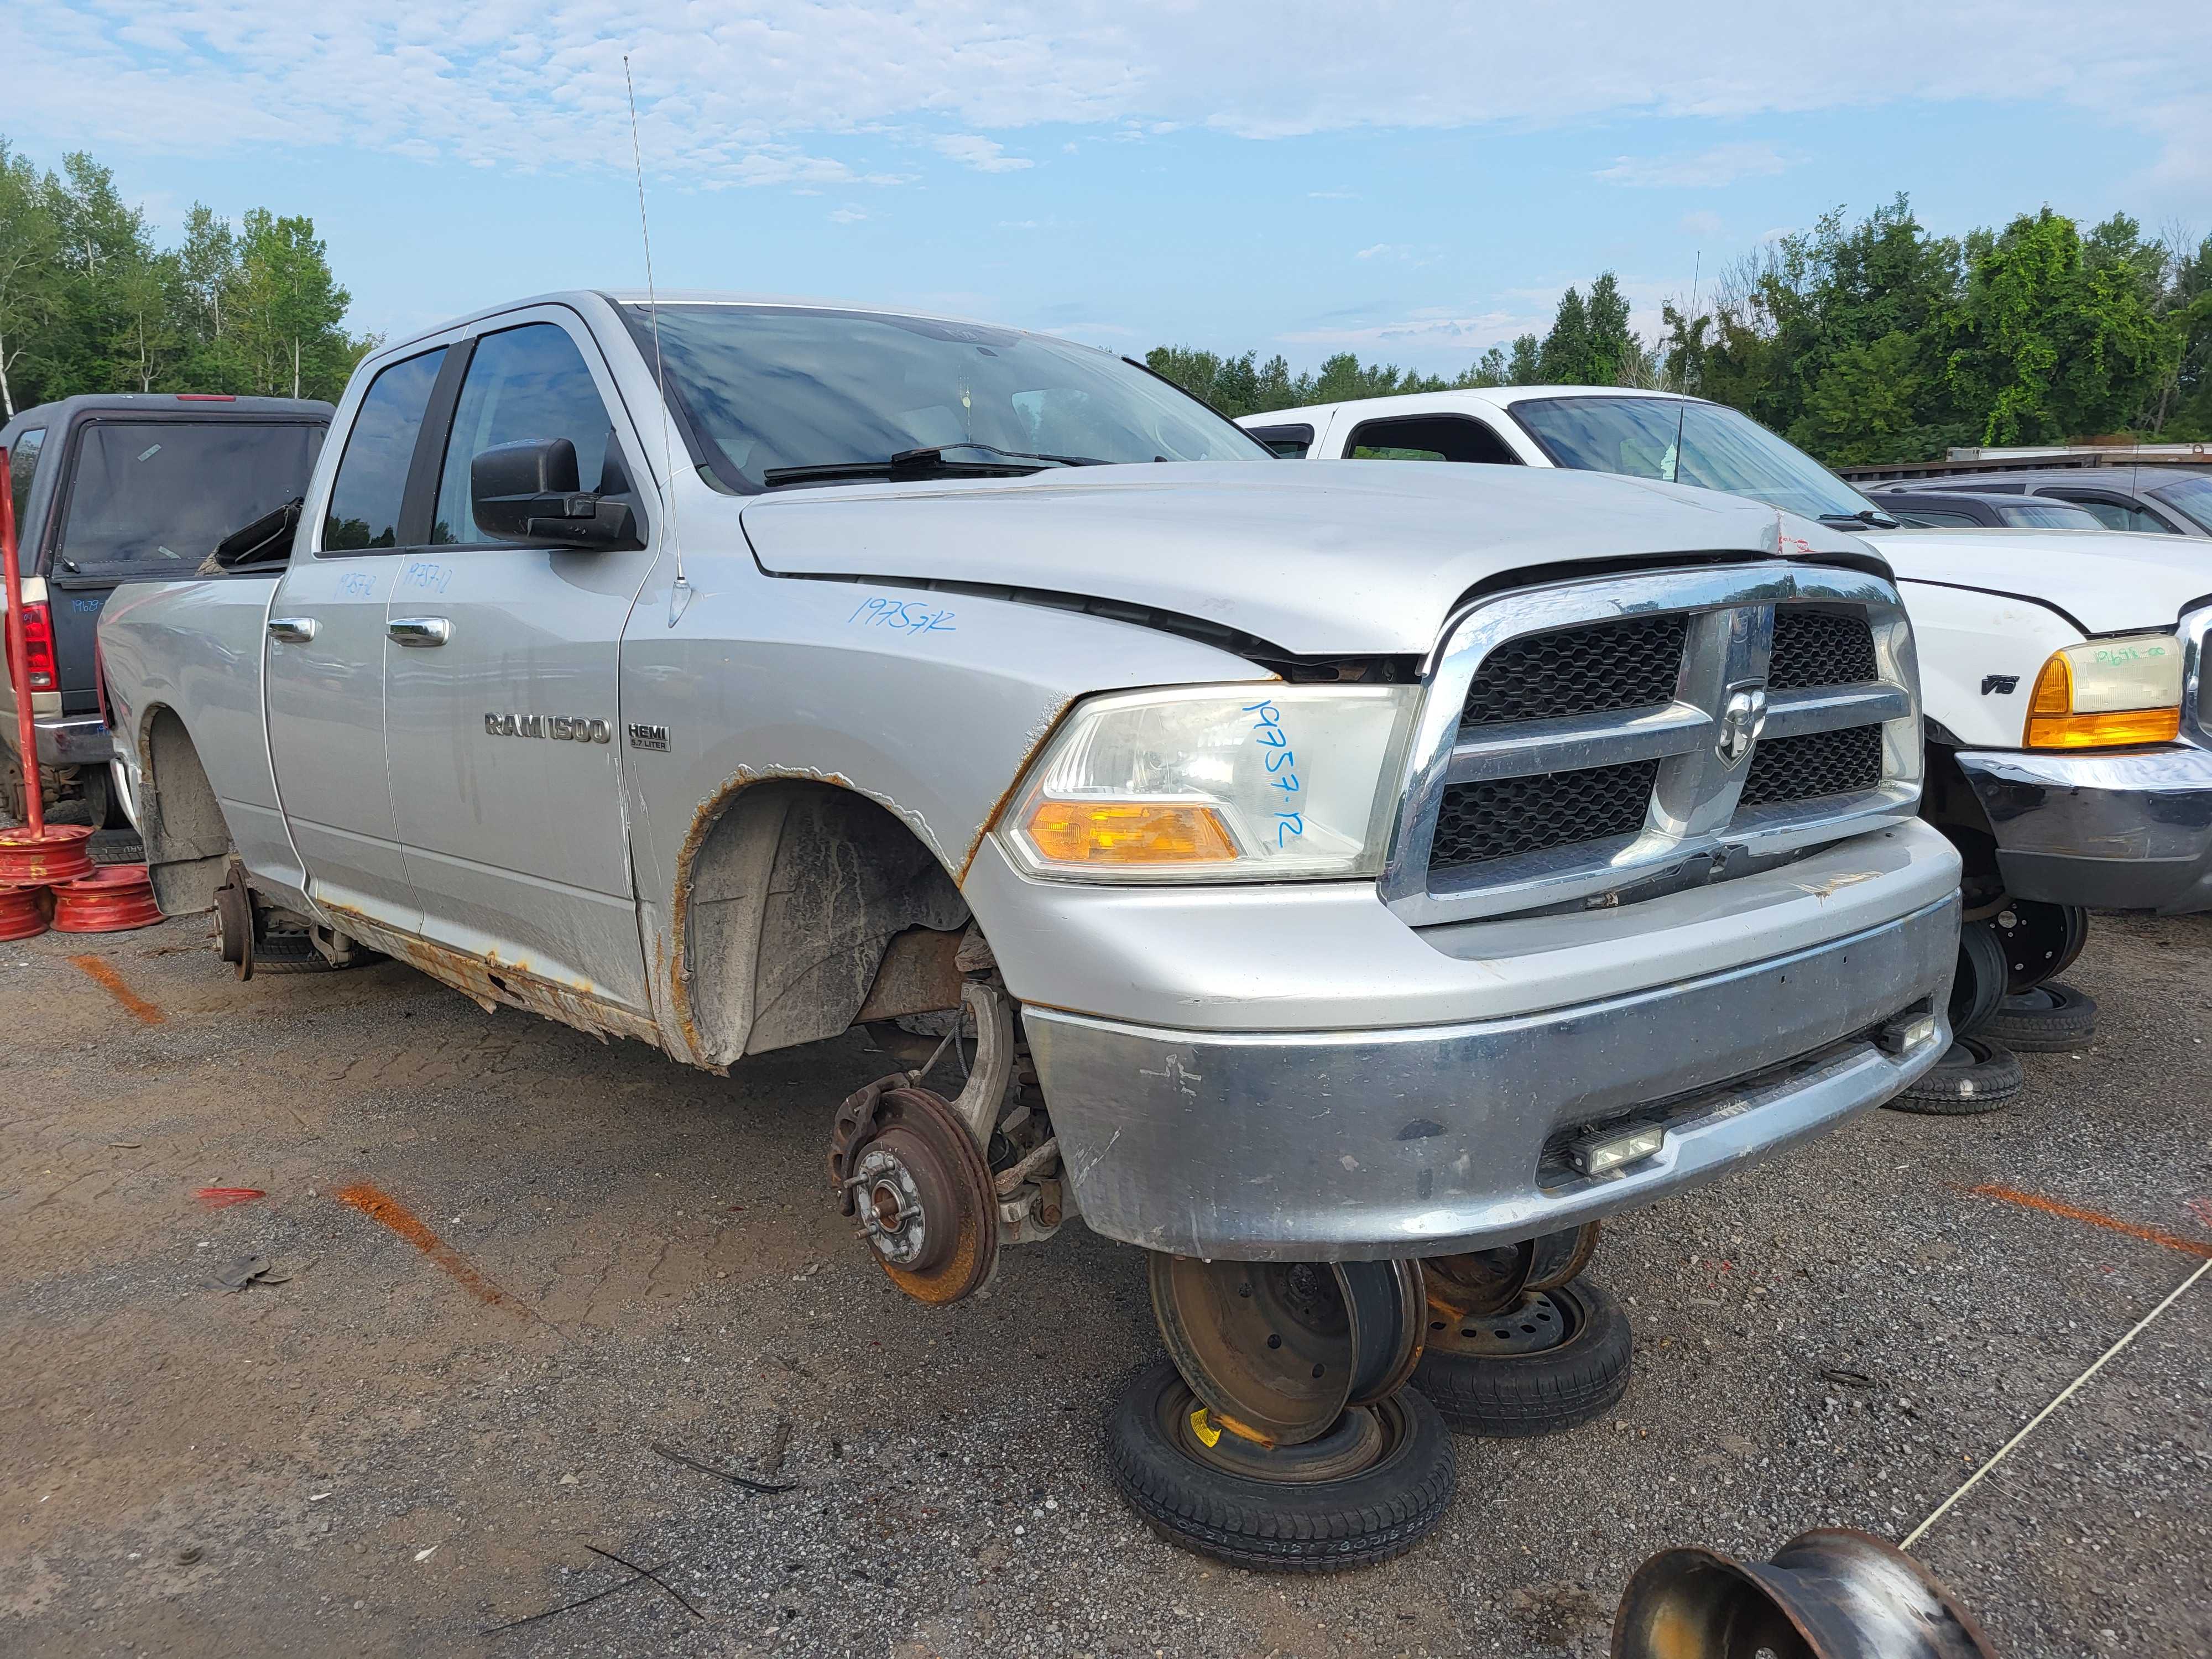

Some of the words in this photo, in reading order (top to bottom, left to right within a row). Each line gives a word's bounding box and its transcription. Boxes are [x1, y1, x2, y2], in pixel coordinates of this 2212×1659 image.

[485, 712, 546, 738] RAM
[547, 716, 611, 743] 1500
[628, 722, 667, 739] HEMI
[645, 741, 666, 750] LITER
